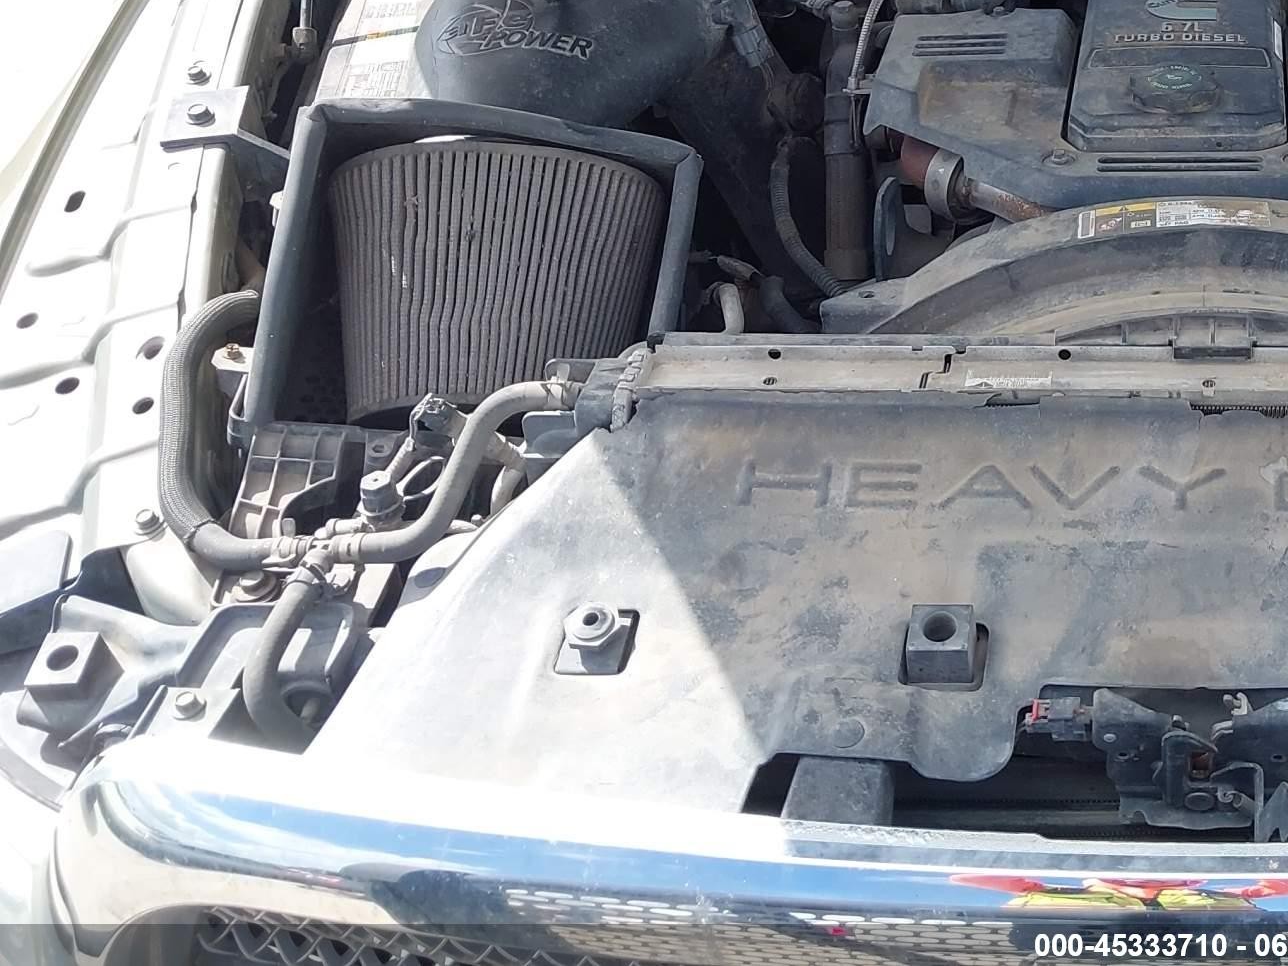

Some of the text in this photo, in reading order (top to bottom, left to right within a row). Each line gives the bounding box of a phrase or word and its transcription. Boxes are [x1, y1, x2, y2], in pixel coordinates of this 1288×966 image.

[1114, 33, 1248, 44] TURBO DIESEL
[1160, 22, 1204, 34] 67L
[480, 28, 594, 60] POWER
[736, 459, 1226, 511] HEAVY
